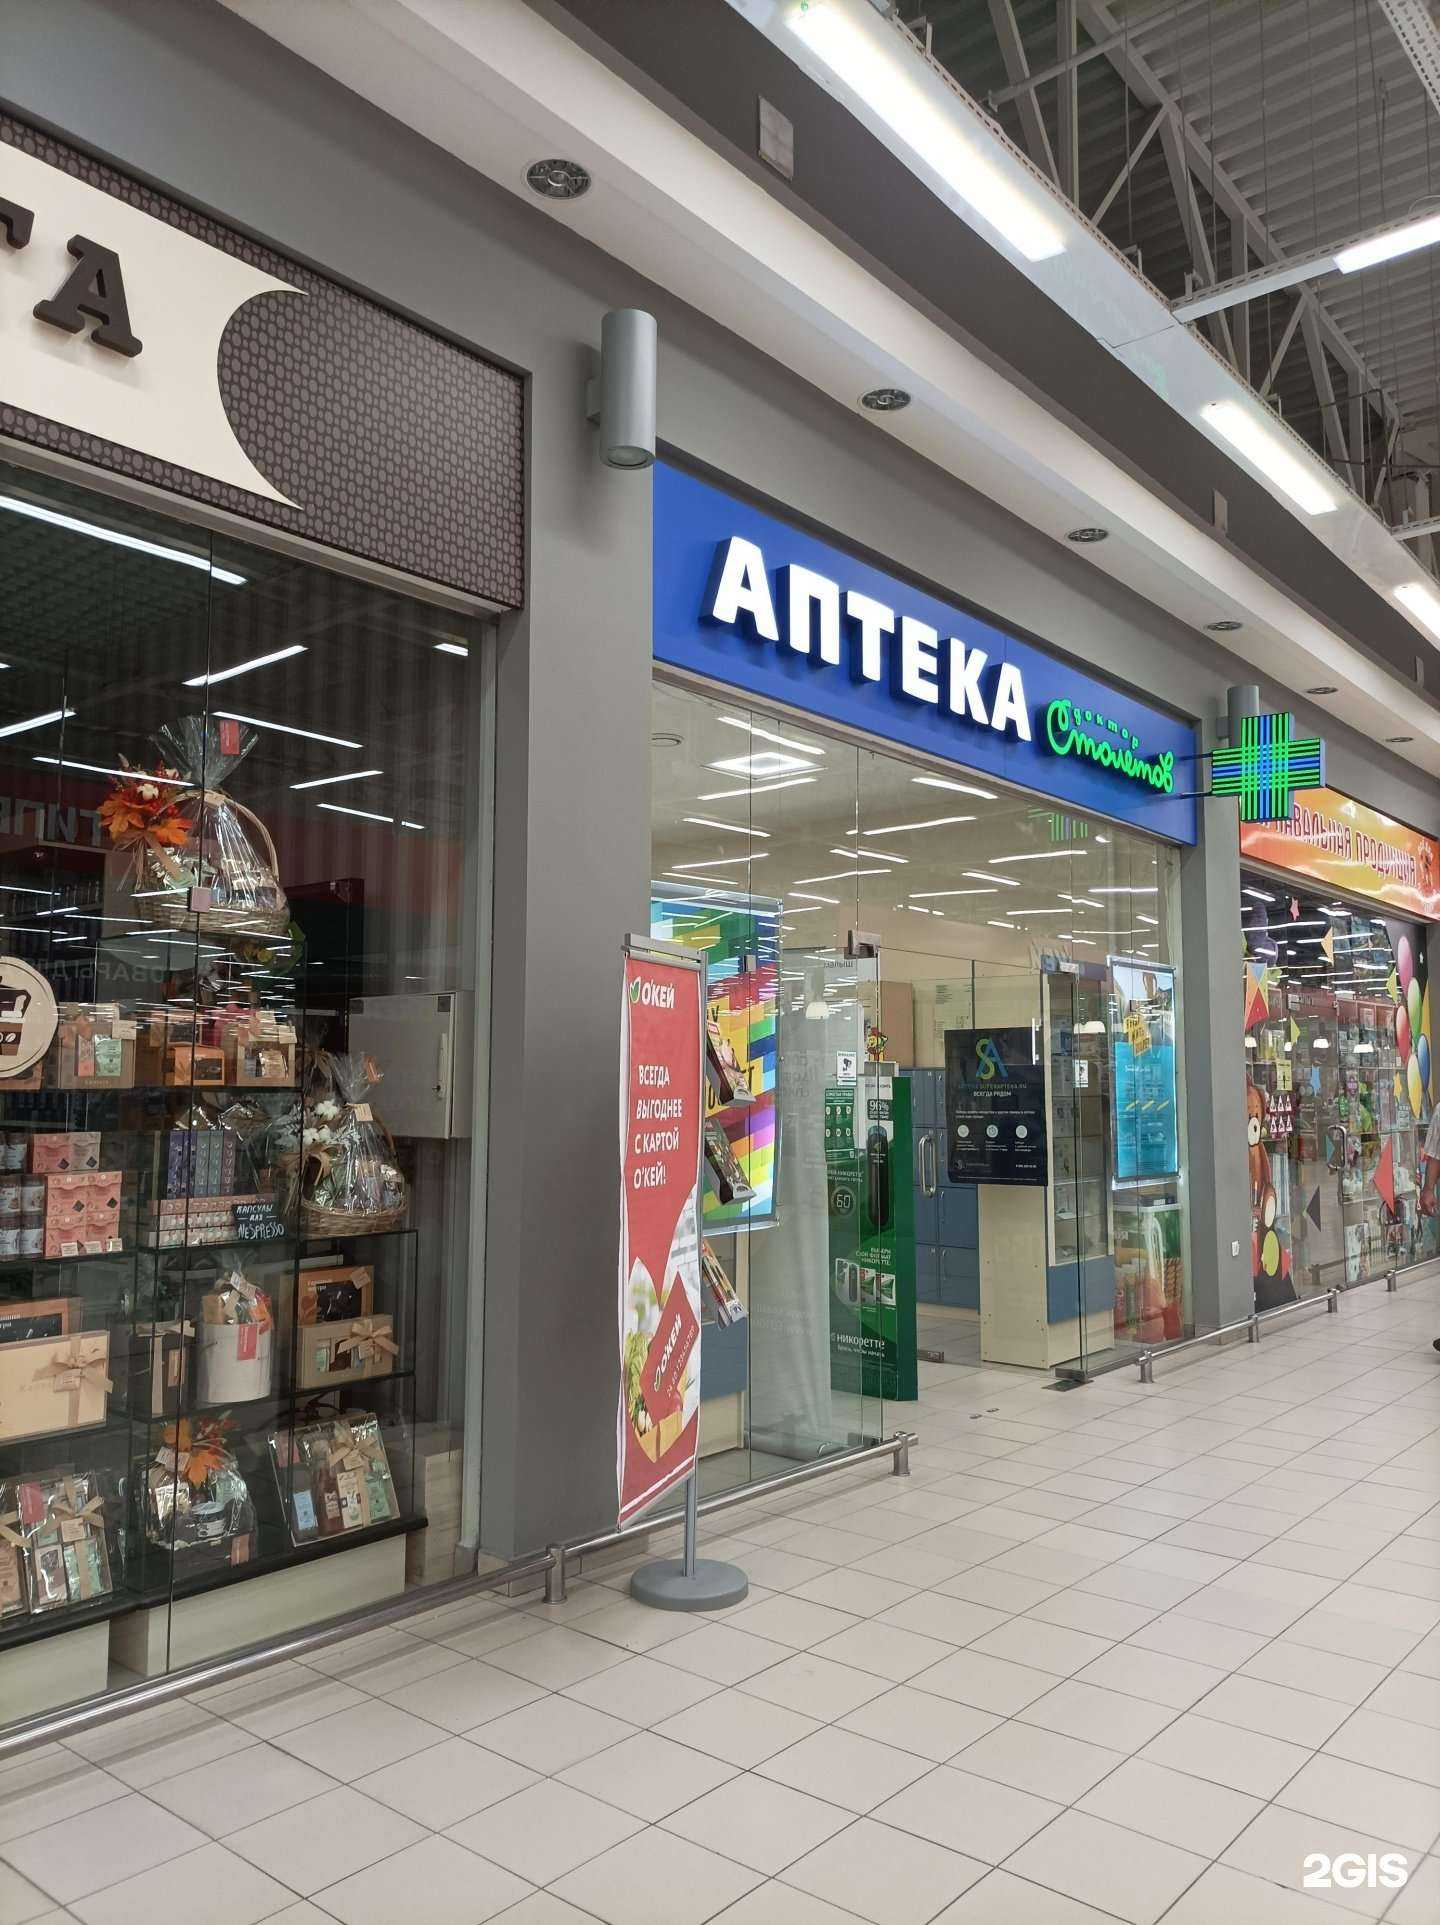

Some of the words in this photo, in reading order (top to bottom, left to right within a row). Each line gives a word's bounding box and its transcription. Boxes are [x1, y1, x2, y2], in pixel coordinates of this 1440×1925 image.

[706, 535, 1032, 742] АПТЕКА
[1046, 699, 1175, 793] Столетов
[638, 1064, 670, 1088] ВСЕГДА
[636, 1098, 683, 1120] ВЫГОДНЕЕ
[635, 1134, 642, 1154] С
[643, 1126, 680, 1154] КАРТОЙ
[633, 1161, 667, 1190] О'КЕЙ!
[238, 1221, 285, 1240] NESPRESSO
